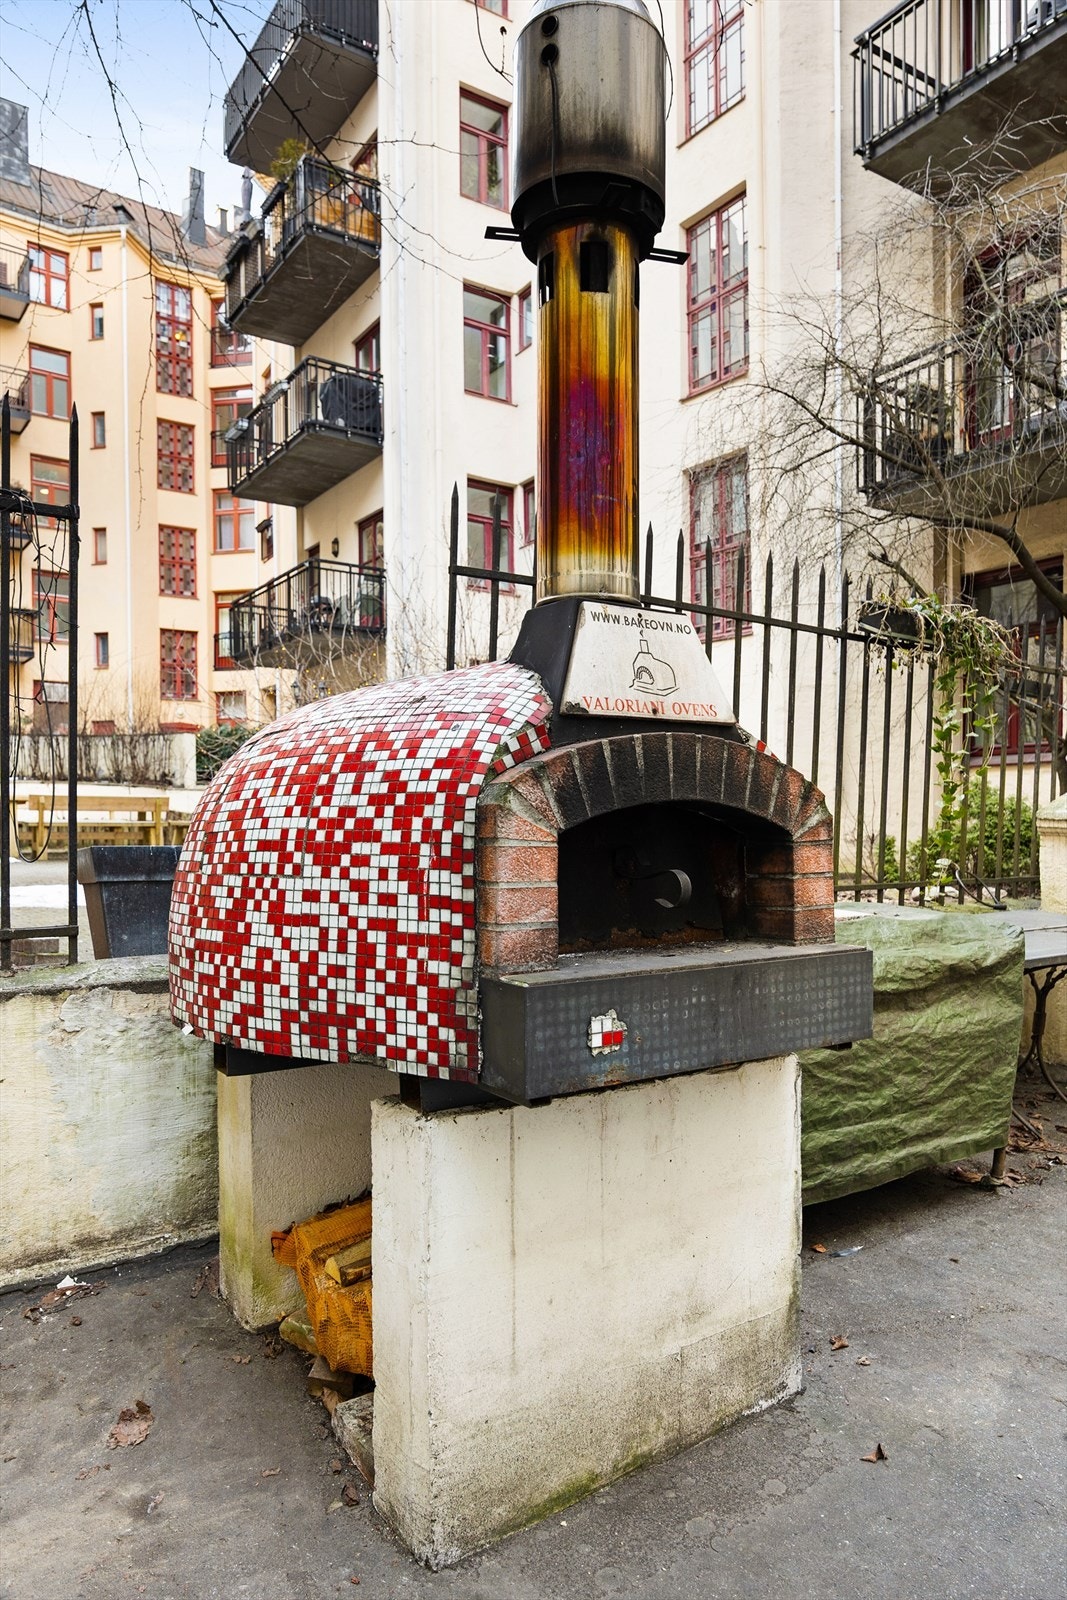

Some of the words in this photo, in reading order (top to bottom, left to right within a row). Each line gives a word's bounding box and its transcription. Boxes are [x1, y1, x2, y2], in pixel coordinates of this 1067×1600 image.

[590, 611, 692, 635] WWW.BAKEOVN.NO
[582, 696, 666, 715] VALORIANI
[672, 702, 718, 717] OVENS
